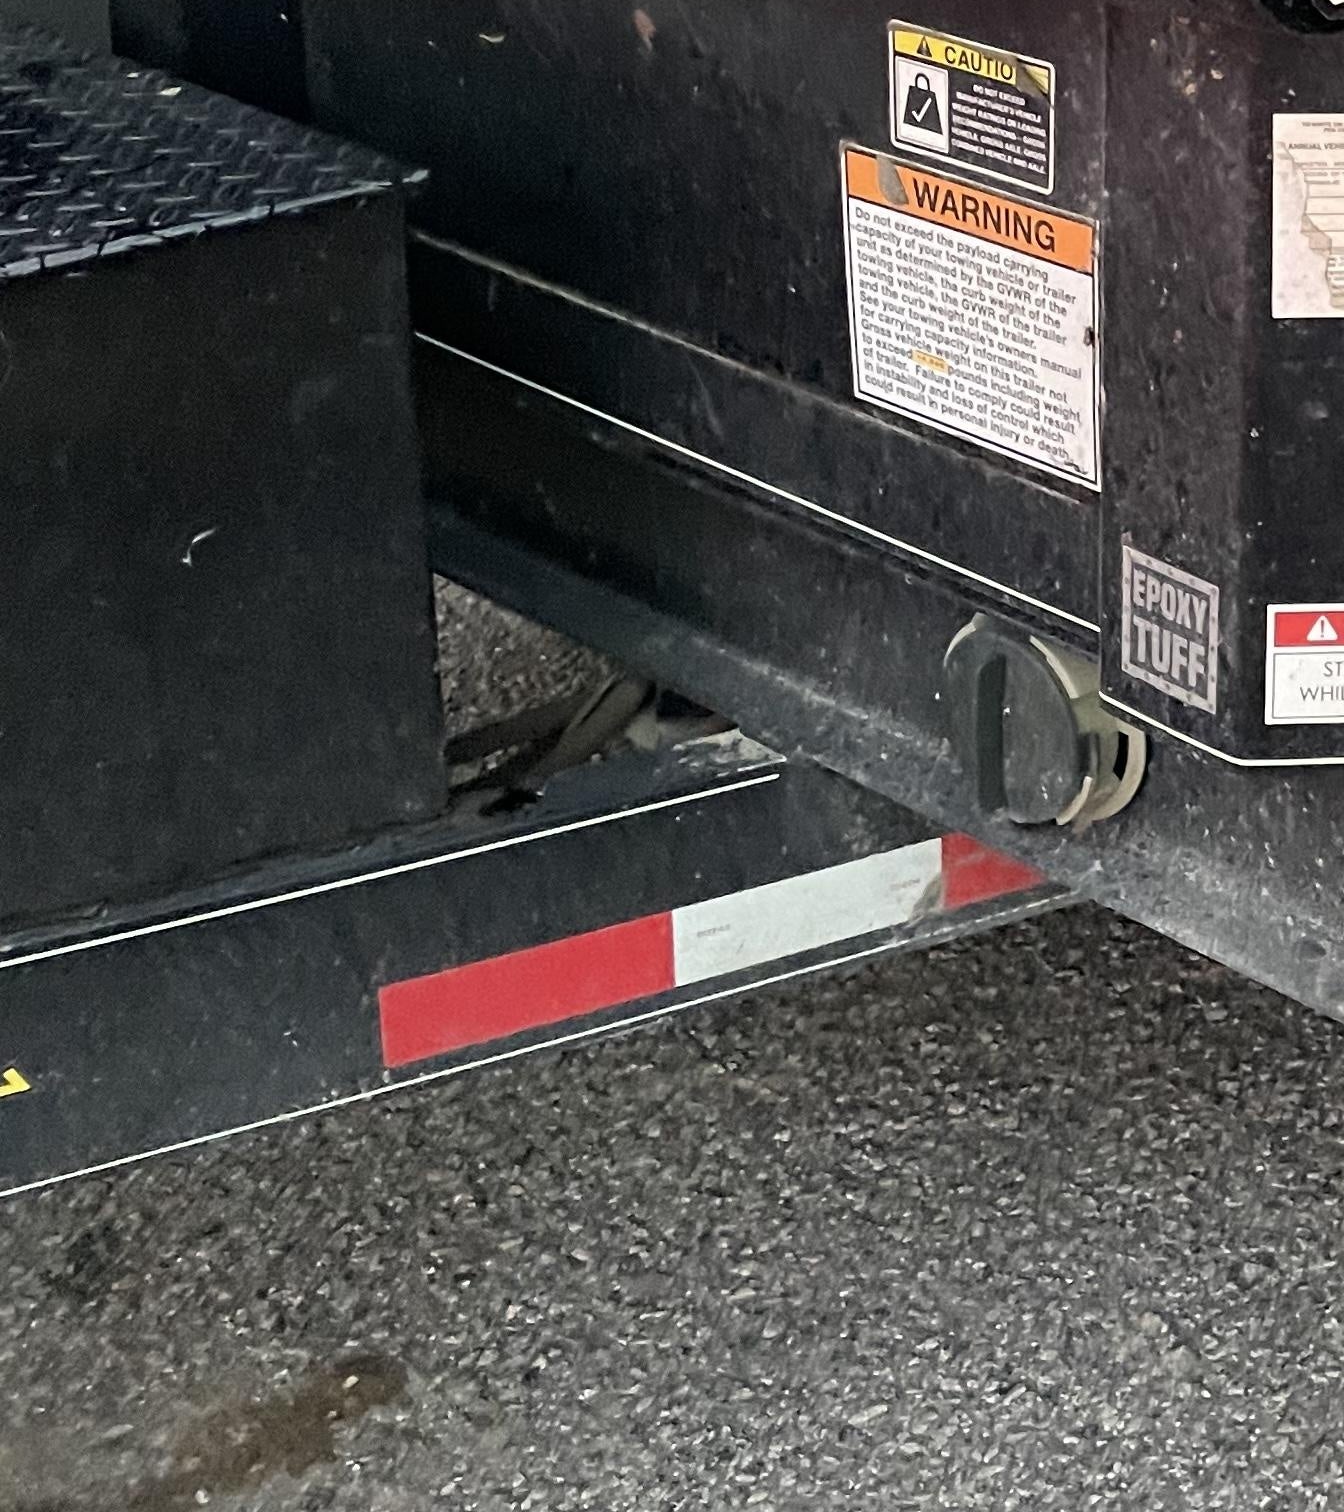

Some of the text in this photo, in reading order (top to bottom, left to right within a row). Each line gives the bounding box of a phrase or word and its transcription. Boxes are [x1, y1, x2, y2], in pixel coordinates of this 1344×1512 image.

[944, 46, 1013, 80] CAUTIO
[855, 207, 1049, 283] Do not exceed the payload carrying
[912, 177, 1055, 253] WARNING
[855, 224, 1076, 304] capacity of your towing vehicle or trailer
[856, 237, 1067, 316] unit as determined by the GVWR of the
[857, 249, 1061, 329] towing vehicle, the curb weight of the
[858, 263, 1067, 346] towing vehicle, the GVWR of the trailer
[859, 278, 1037, 349] and the curb weight of the trailer.
[860, 290, 1081, 379] See your towing vehicle's owners manual
[860, 304, 875, 319] for
[878, 313, 921, 337] carrying
[924, 329, 969, 354] capacity
[972, 345, 1038, 378] information.
[861, 318, 892, 338] Gross
[894, 332, 931, 353] vehicle
[935, 347, 971, 368] weight
[974, 361, 988, 374] on
[990, 366, 1010, 382] this
[1013, 374, 1045, 395] trailer
[1049, 389, 1068, 403] not
[862, 332, 1081, 423] to exceed pounds including weight
[863, 347, 873, 358] of
[876, 350, 909, 372] trailer.
[915, 365, 951, 387] Failure
[954, 380, 965, 392] to
[968, 387, 1007, 410] comply
[1010, 402, 1040, 421] could
[1043, 416, 1075, 435] result
[864, 359, 1064, 444] in instability and loss of control which
[864, 374, 1035, 446] could result in personal injury or
[1133, 568, 1208, 634] EPOXY
[1133, 614, 1206, 688] TUFF
